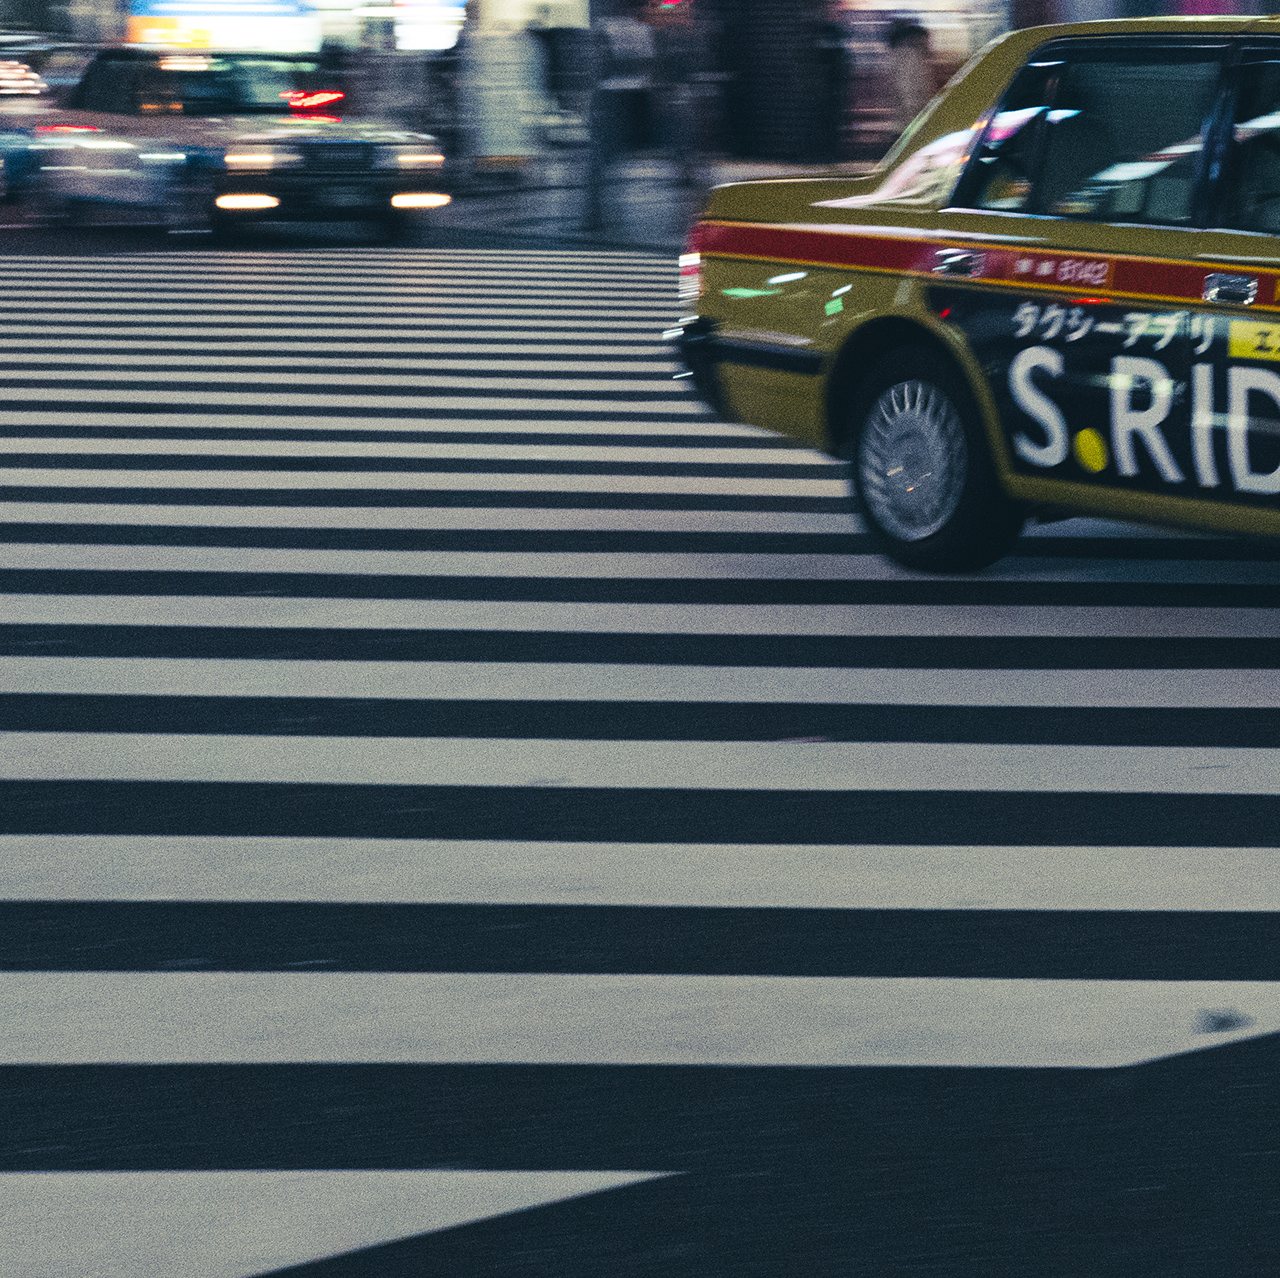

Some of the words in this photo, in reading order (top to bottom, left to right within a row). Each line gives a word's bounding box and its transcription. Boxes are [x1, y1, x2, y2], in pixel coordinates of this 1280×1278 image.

[1011, 301, 1216, 355] タクシーアプリ
